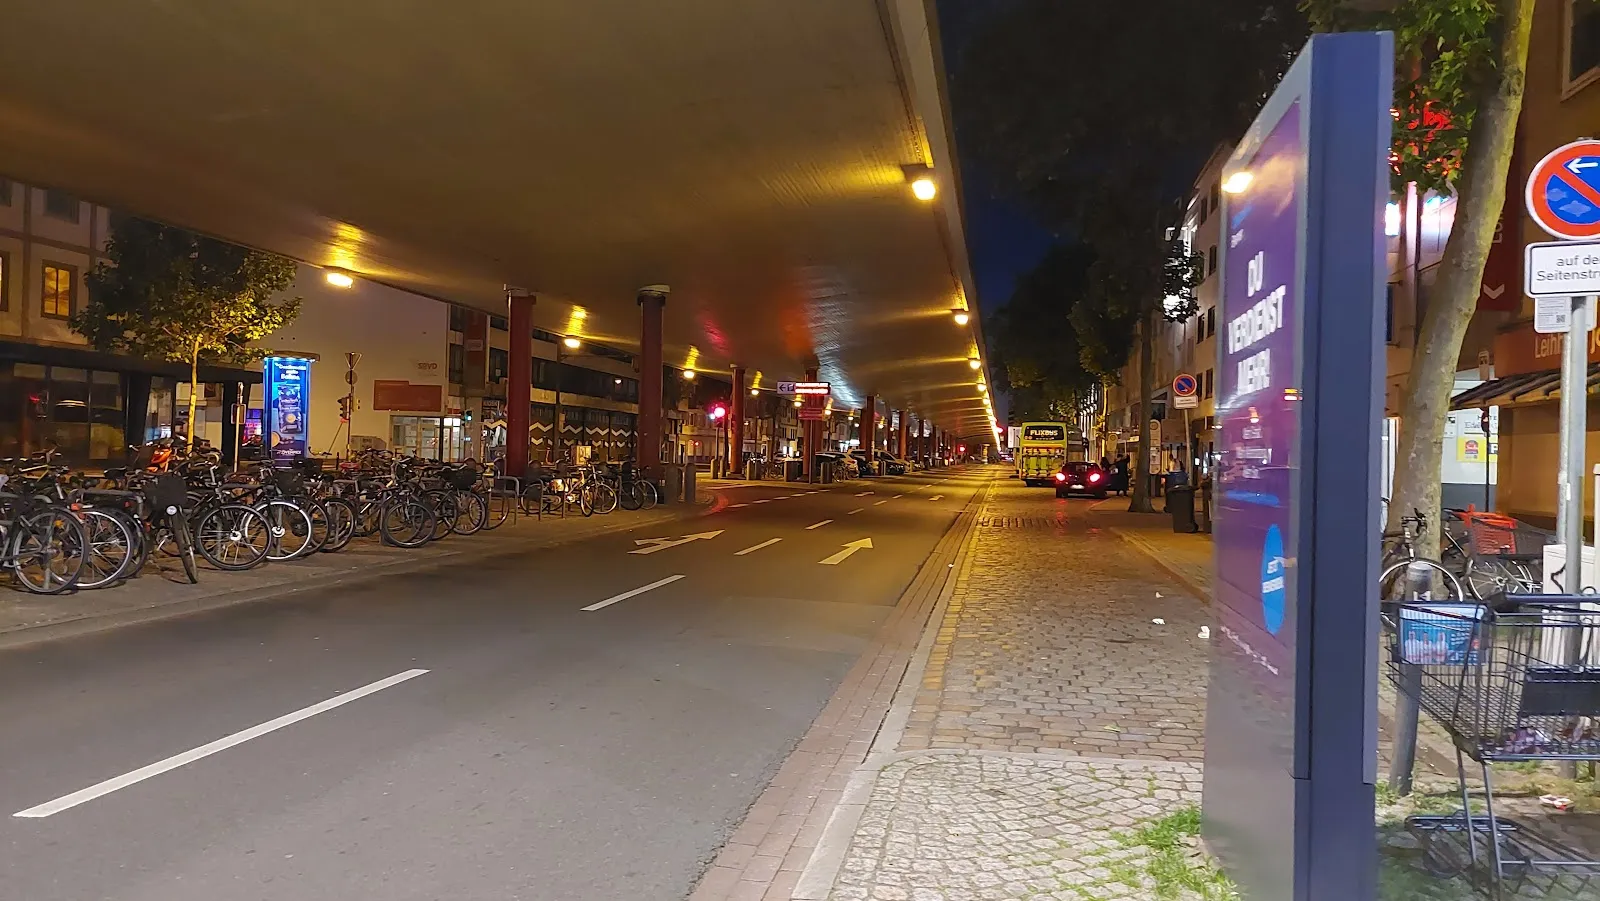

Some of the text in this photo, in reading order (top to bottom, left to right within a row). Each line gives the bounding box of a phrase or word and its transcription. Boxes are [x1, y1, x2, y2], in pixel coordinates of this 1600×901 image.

[1247, 251, 1264, 297] DU
[1536, 269, 1600, 282] Seitenstr
[1556, 254, 1580, 267] auf
[1228, 284, 1286, 355] VERDIENST
[1237, 348, 1271, 396] MEHR!
